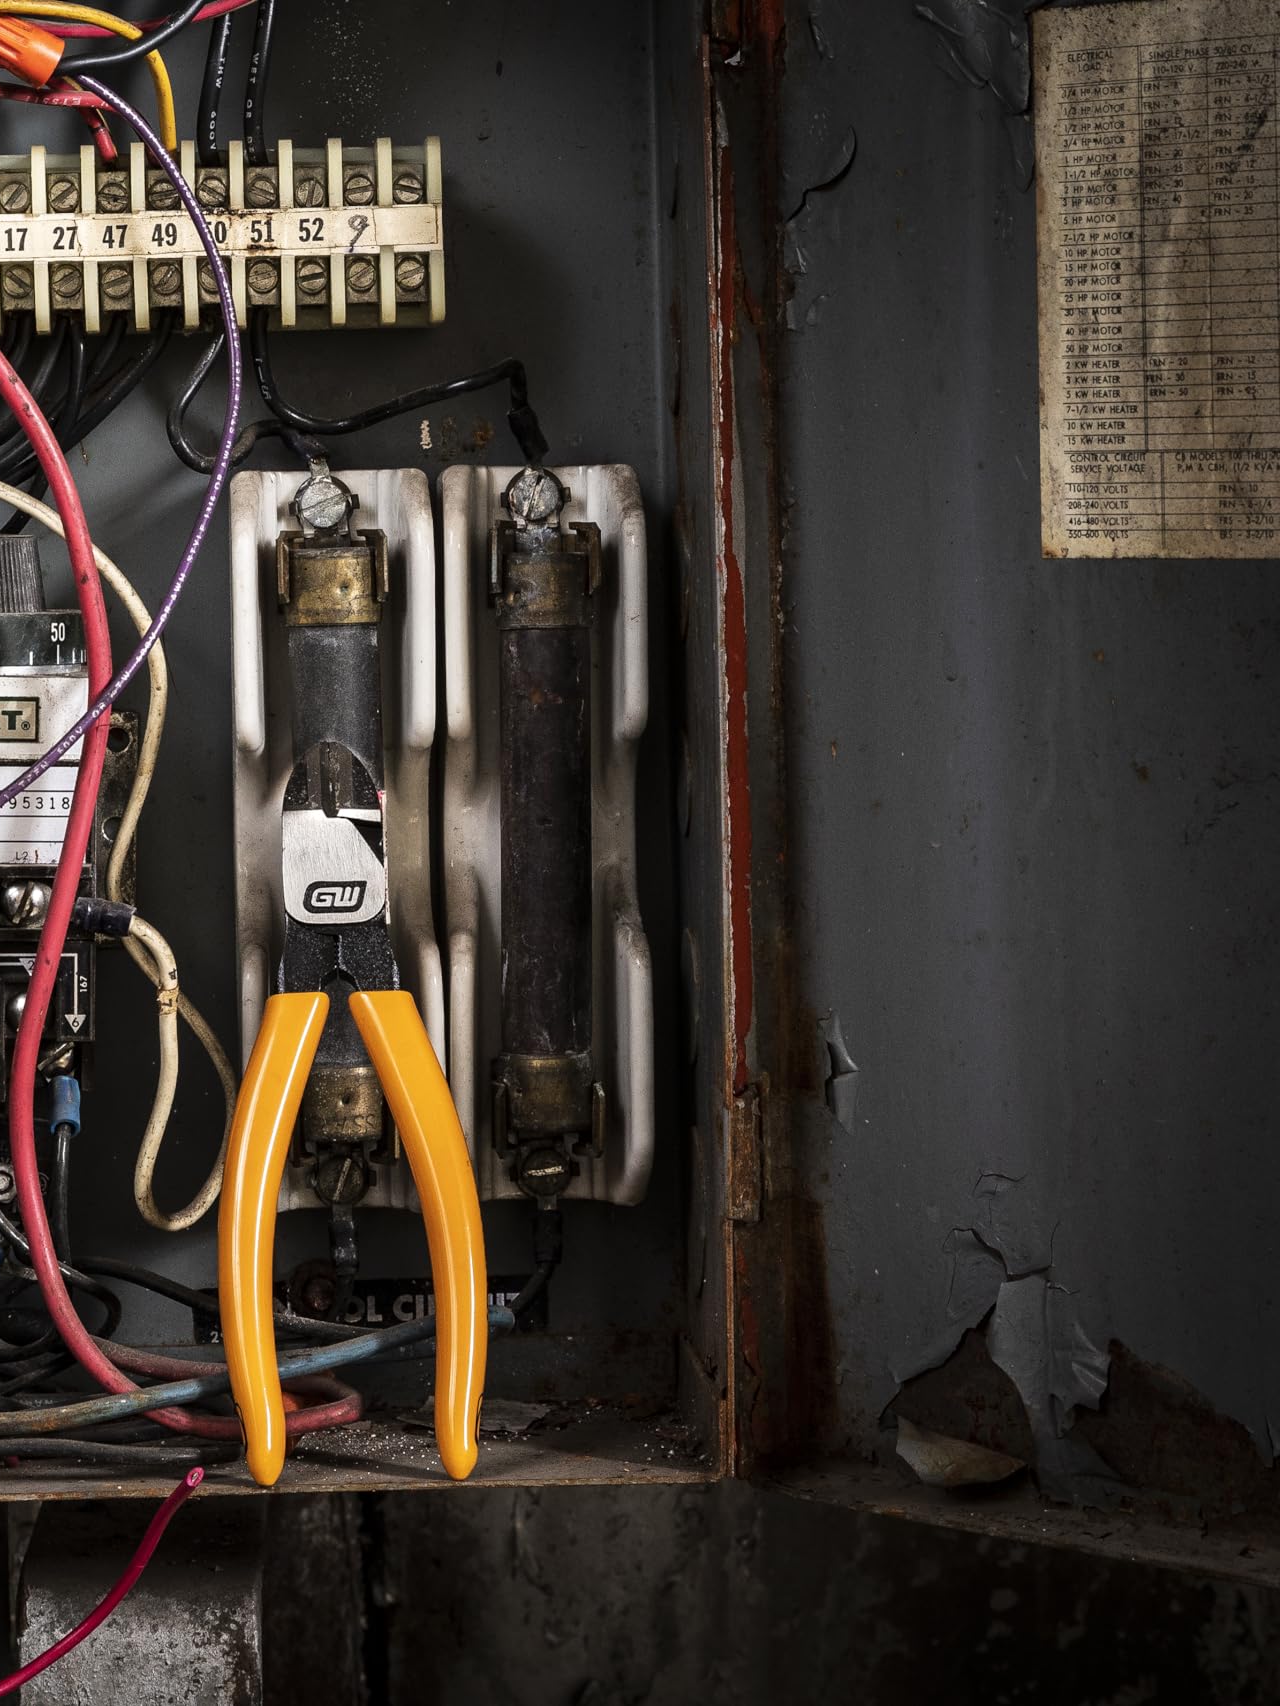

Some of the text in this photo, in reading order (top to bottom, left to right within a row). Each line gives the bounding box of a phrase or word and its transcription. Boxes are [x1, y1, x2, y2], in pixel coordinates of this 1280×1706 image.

[1067, 51, 1113, 63] ELECTRICAL
[1149, 49, 1180, 60] SINGLE
[1184, 47, 1209, 57] PHASE
[1078, 62, 1101, 72] LOAD
[1081, 123, 1091, 132] HP
[1095, 120, 1125, 130] MOTOR
[1081, 138, 1091, 146] HP
[1094, 136, 1125, 146] MOTOR
[1073, 155, 1083, 163] HP
[1087, 153, 1117, 163] MOTOR
[1090, 169, 1100, 179] HP
[1104, 167, 1135, 178] MOTOR
[1064, 183, 1117, 194] 2 HP MOTOR
[1072, 216, 1083, 224] HP
[1086, 214, 1117, 224] MOTOR
[4, 227, 28, 251] 17
[52, 226, 78, 250] 27
[102, 224, 128, 248] 47
[152, 222, 177, 247] 49
[250, 219, 275, 243] 51
[298, 217, 325, 242] 52
[1063, 231, 1134, 244] 7-1/2 HP MOTOR
[1065, 247, 1121, 258] 10 HP MOTOR
[1077, 264, 1088, 272] HP
[1091, 261, 1121, 271] MOTOR
[1064, 292, 1122, 303] 25 HP MOTOR
[1079, 327, 1089, 336] HP
[1092, 326, 1122, 335] MOTOR
[1065, 343, 1123, 353] 50 HP MOTOR
[1066, 361, 1071, 370] 2
[1074, 361, 1088, 369] KW
[1092, 360, 1121, 369] HEATER
[1074, 376, 1088, 384] KW
[1092, 375, 1121, 384] HEATER
[1066, 390, 1071, 399] 5
[1075, 390, 1089, 398] KW
[1092, 389, 1121, 398] HEATER
[1092, 405, 1106, 414] KW
[1110, 404, 1138, 414] HEATER
[1080, 421, 1093, 430] KW
[1097, 421, 1126, 430] HEATER
[1080, 437, 1094, 445] KW
[1097, 436, 1126, 445] HEATER
[1069, 453, 1146, 463] CONTROL CIRCUIT
[1070, 464, 1146, 474] SERVICE VOLTAGE
[1069, 484, 1099, 494] 110-120
[1103, 485, 1129, 494] VOLTS
[1067, 500, 1129, 510] 208-240 VOLTS
[1069, 517, 1099, 526] 416-480
[1103, 517, 1129, 526] VOLTS
[1103, 530, 1129, 539] VOLTS
[50, 622, 66, 642] 50
[15, 851, 29, 861] L2
[310, 886, 361, 907] GW
[72, 1018, 80, 1028] 6
